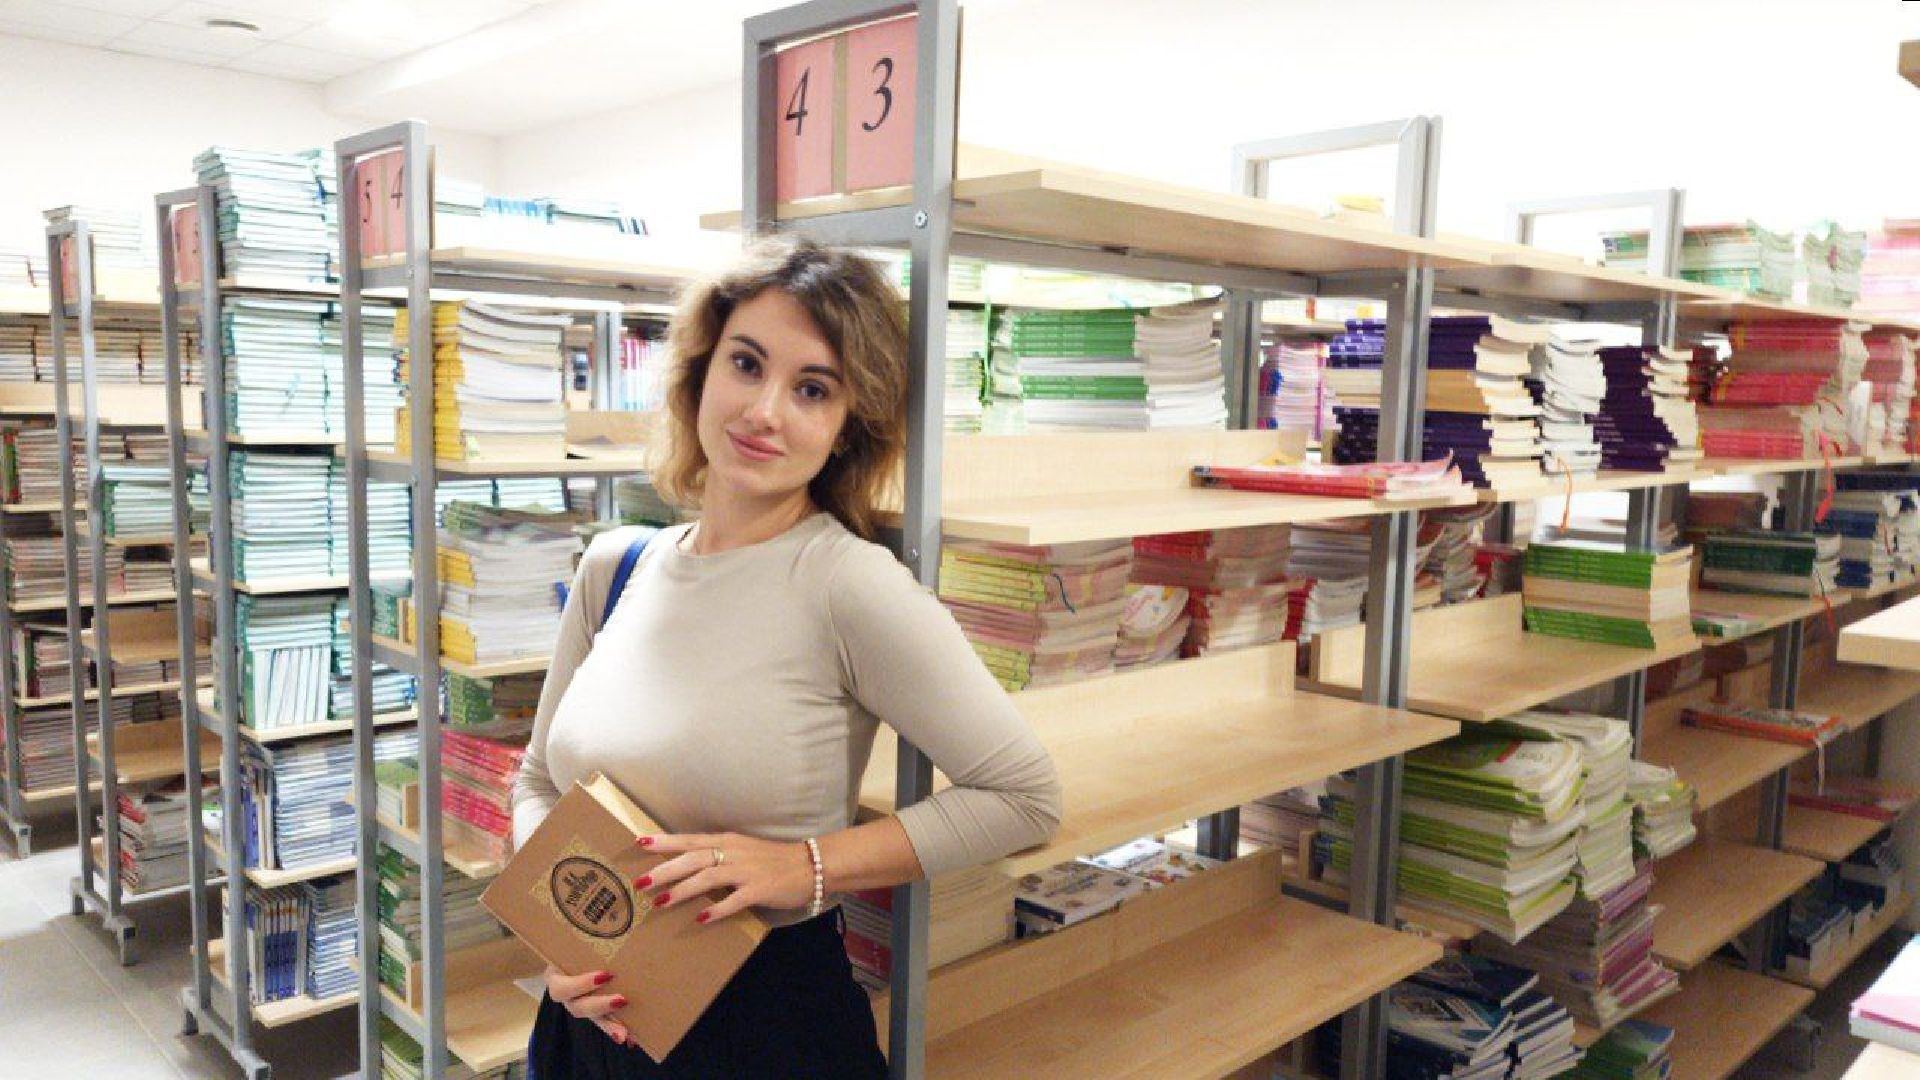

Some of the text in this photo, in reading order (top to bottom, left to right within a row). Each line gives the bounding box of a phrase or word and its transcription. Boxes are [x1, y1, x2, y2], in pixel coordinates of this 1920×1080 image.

[786, 66, 810, 136] 4
[862, 57, 893, 132] 3
[390, 164, 404, 210] 4
